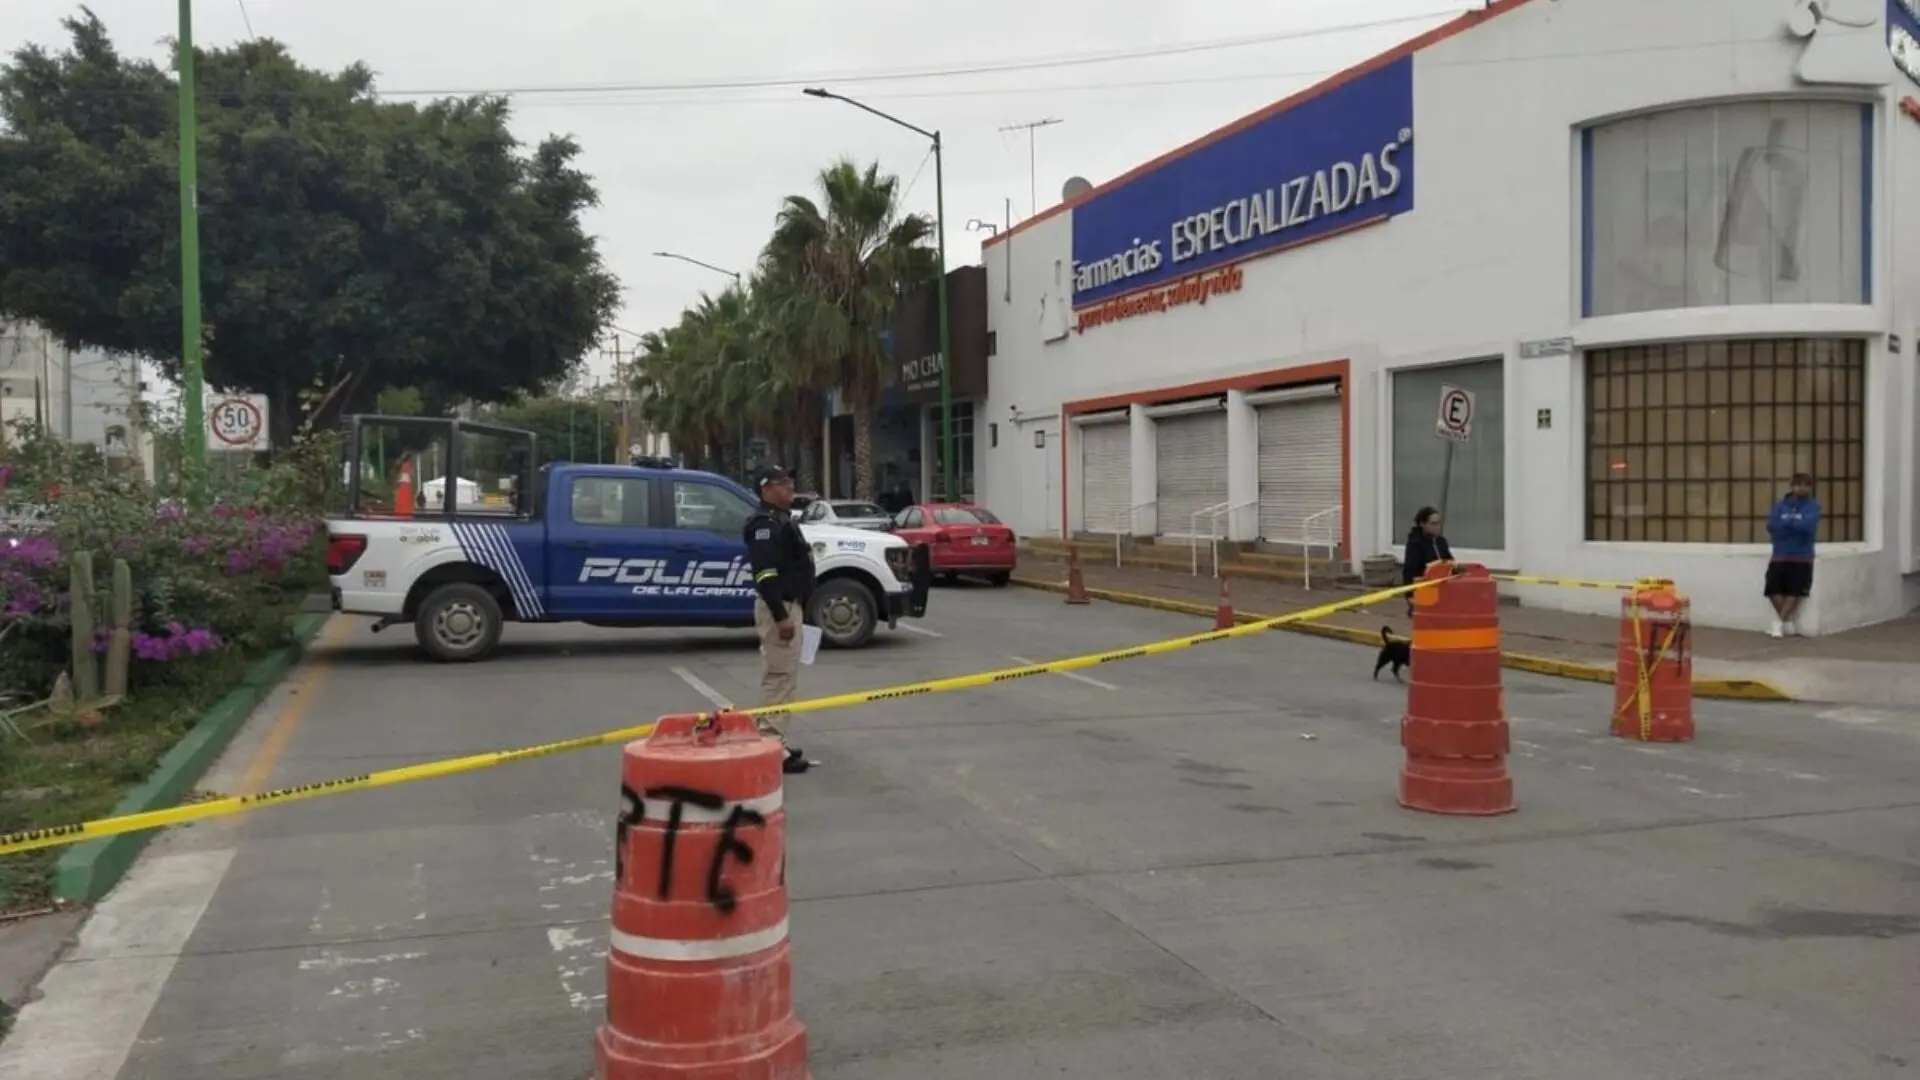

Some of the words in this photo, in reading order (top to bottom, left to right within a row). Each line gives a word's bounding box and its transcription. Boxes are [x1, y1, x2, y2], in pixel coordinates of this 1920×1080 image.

[1072, 237, 1163, 292] Farmacias
[1171, 142, 1401, 263] ESPECIALIZADAS
[223, 406, 251, 429] 50
[1448, 396, 1465, 425] E
[631, 585, 661, 596] DE
[662, 586, 690, 596] LA
[691, 587, 759, 598] CAPITA
